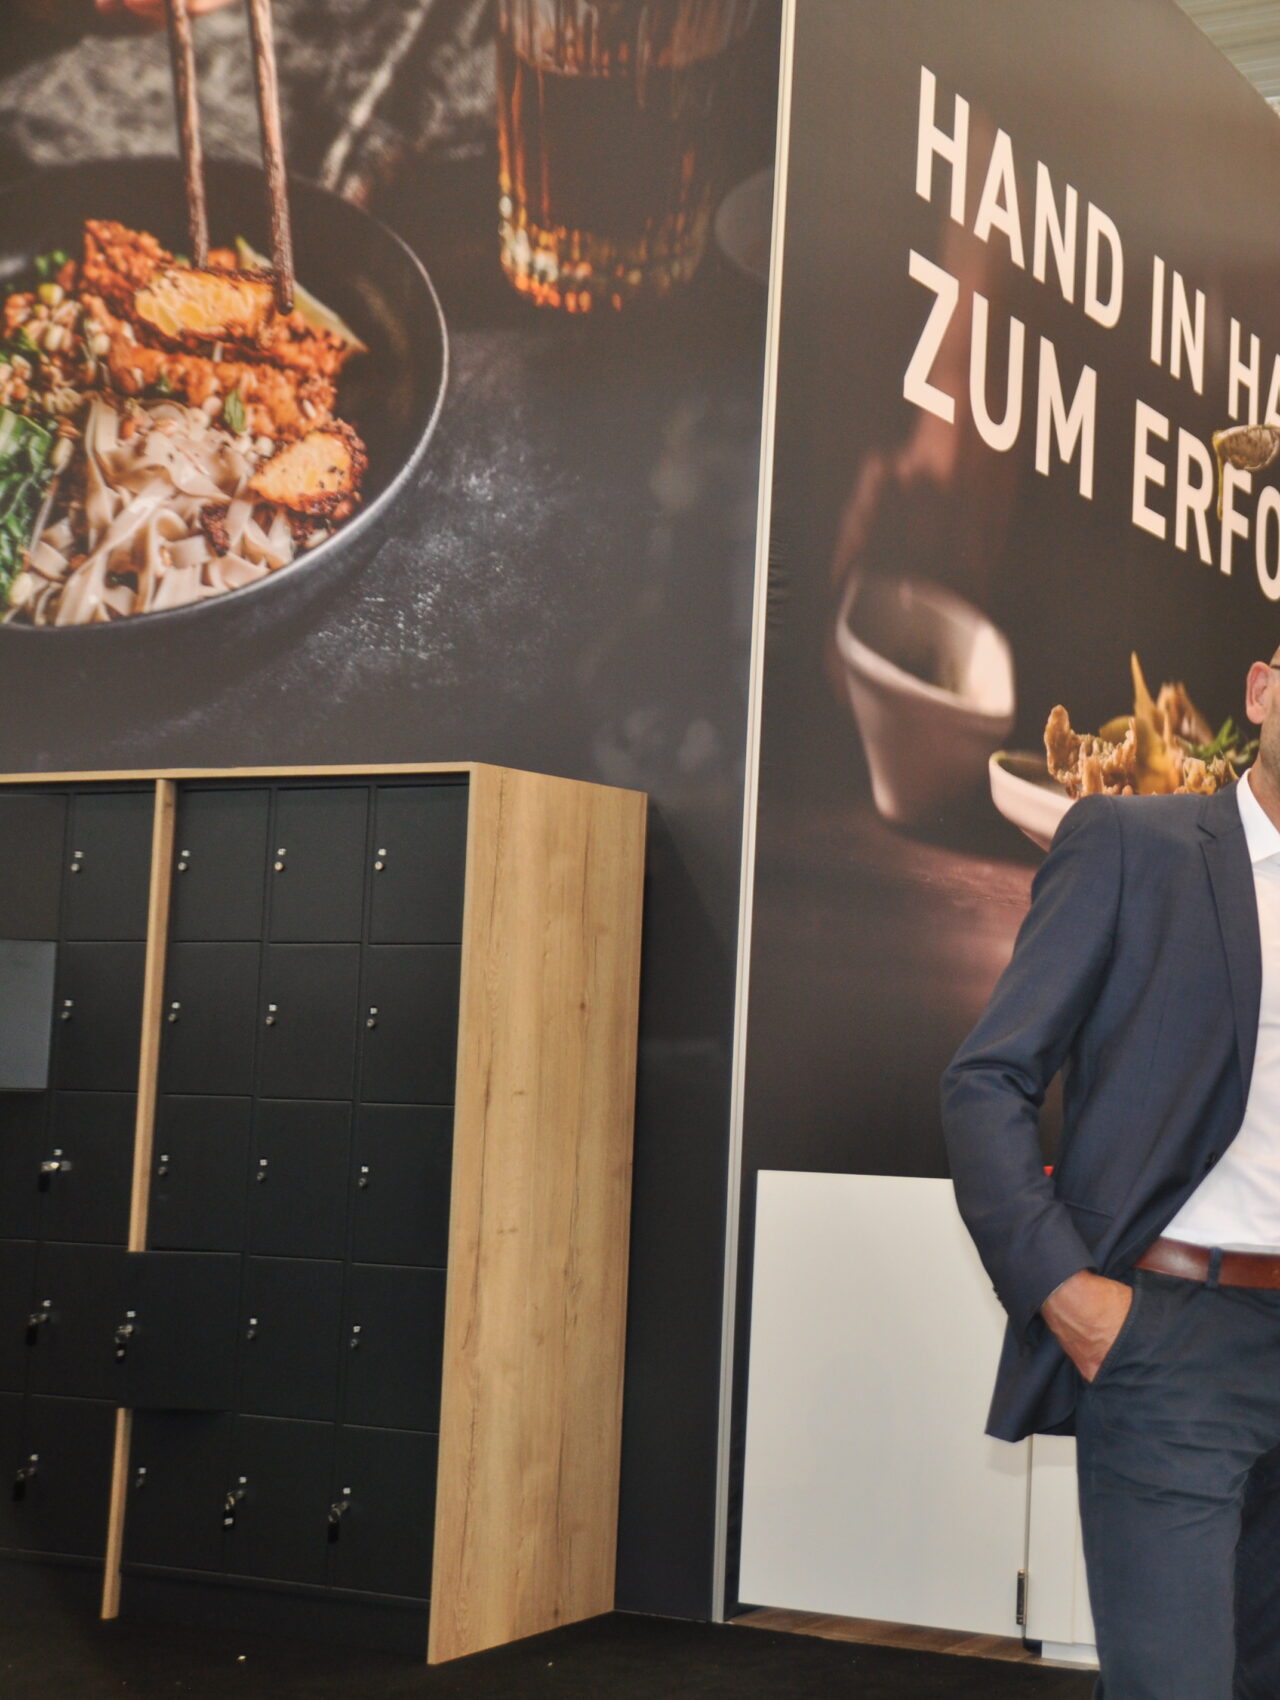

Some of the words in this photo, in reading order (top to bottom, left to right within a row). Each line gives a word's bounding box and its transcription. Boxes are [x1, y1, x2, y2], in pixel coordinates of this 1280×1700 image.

[903, 248, 1097, 500] ZUM
[915, 64, 1124, 329] HAND
[1150, 254, 1206, 396] IN
